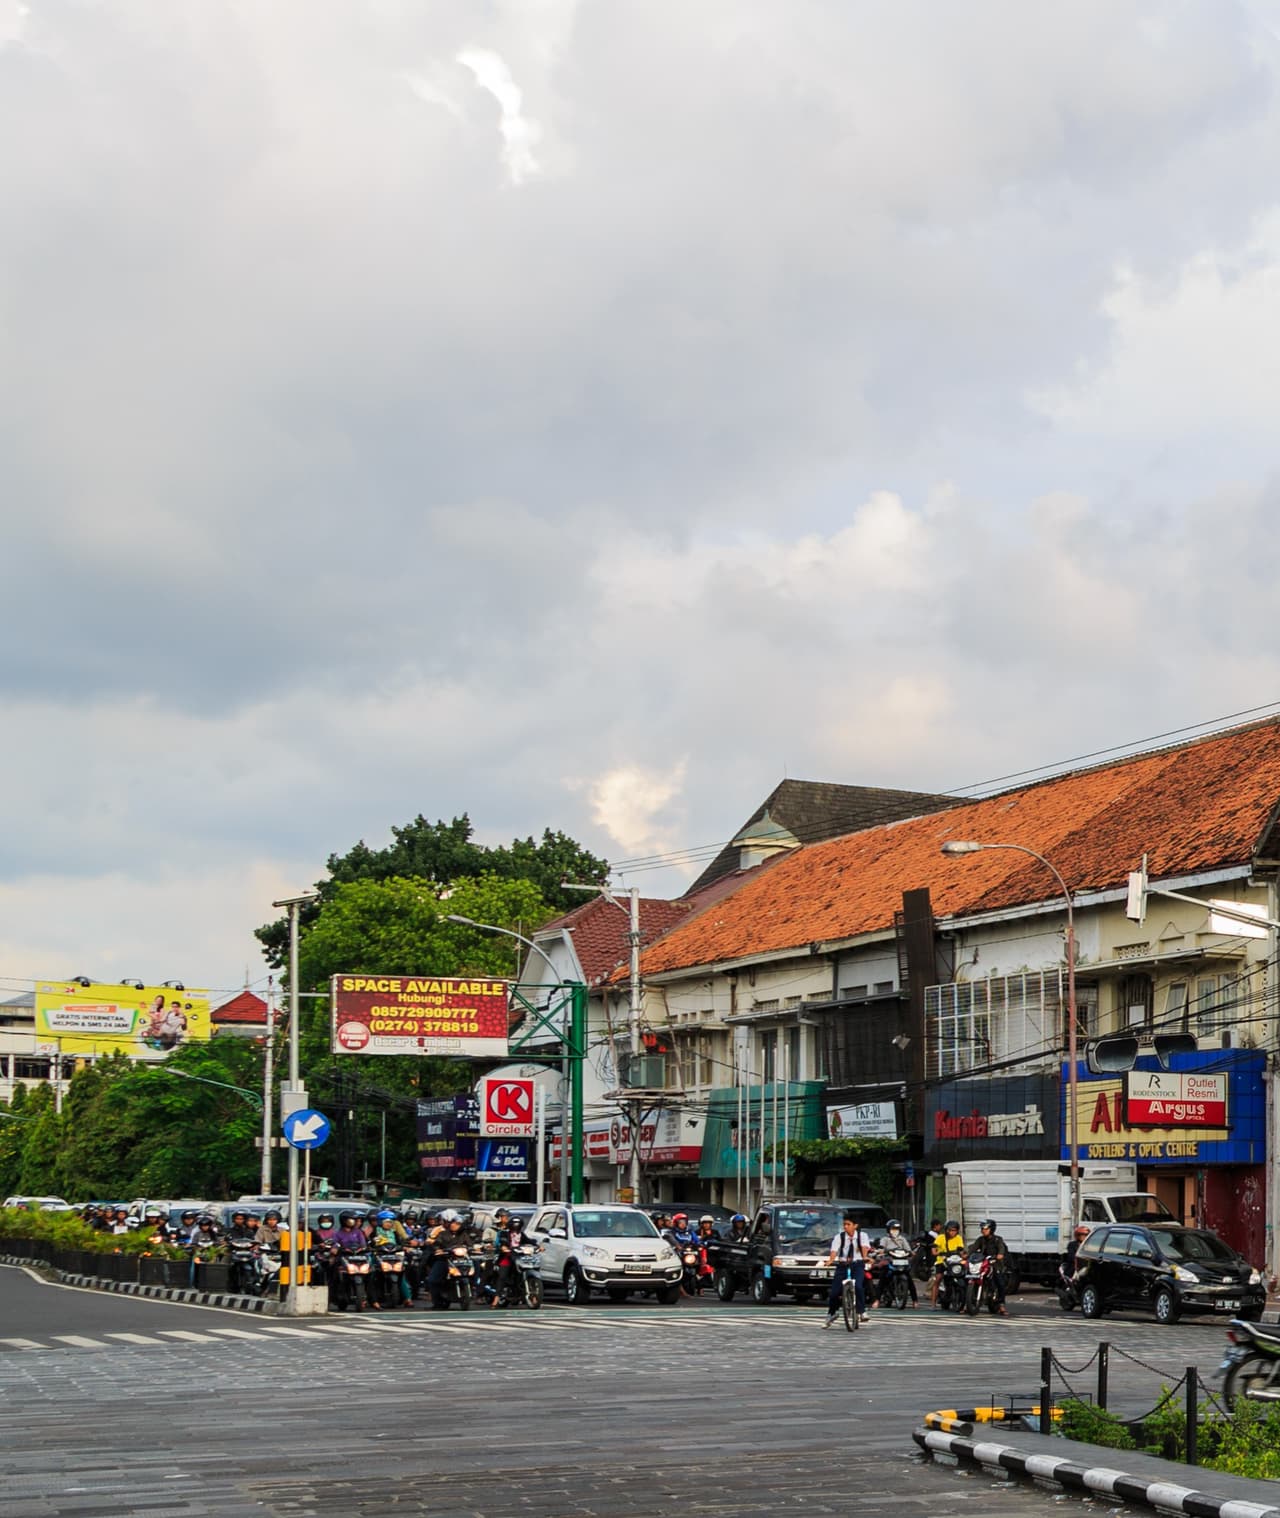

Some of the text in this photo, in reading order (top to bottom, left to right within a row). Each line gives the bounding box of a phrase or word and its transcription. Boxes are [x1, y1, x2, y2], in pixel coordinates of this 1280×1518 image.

[343, 979, 504, 995] SPACE AVAILABLE
[398, 993, 446, 1005] Hubungi
[371, 1006, 478, 1018] 085729909777
[370, 1020, 480, 1033] (0274) 378819
[1188, 1078, 1216, 1088] Outlet
[1188, 1088, 1218, 1098] Resmi
[1148, 1102, 1206, 1120] Argus
[486, 1124, 520, 1134] Circle
[524, 1125, 532, 1134] K
[497, 1146, 520, 1154] ATM
[1129, 1143, 1136, 1158] &
[1139, 1142, 1163, 1158] OPTIC
[1166, 1142, 1198, 1157] CENTRE
[504, 1157, 525, 1166] BCA
